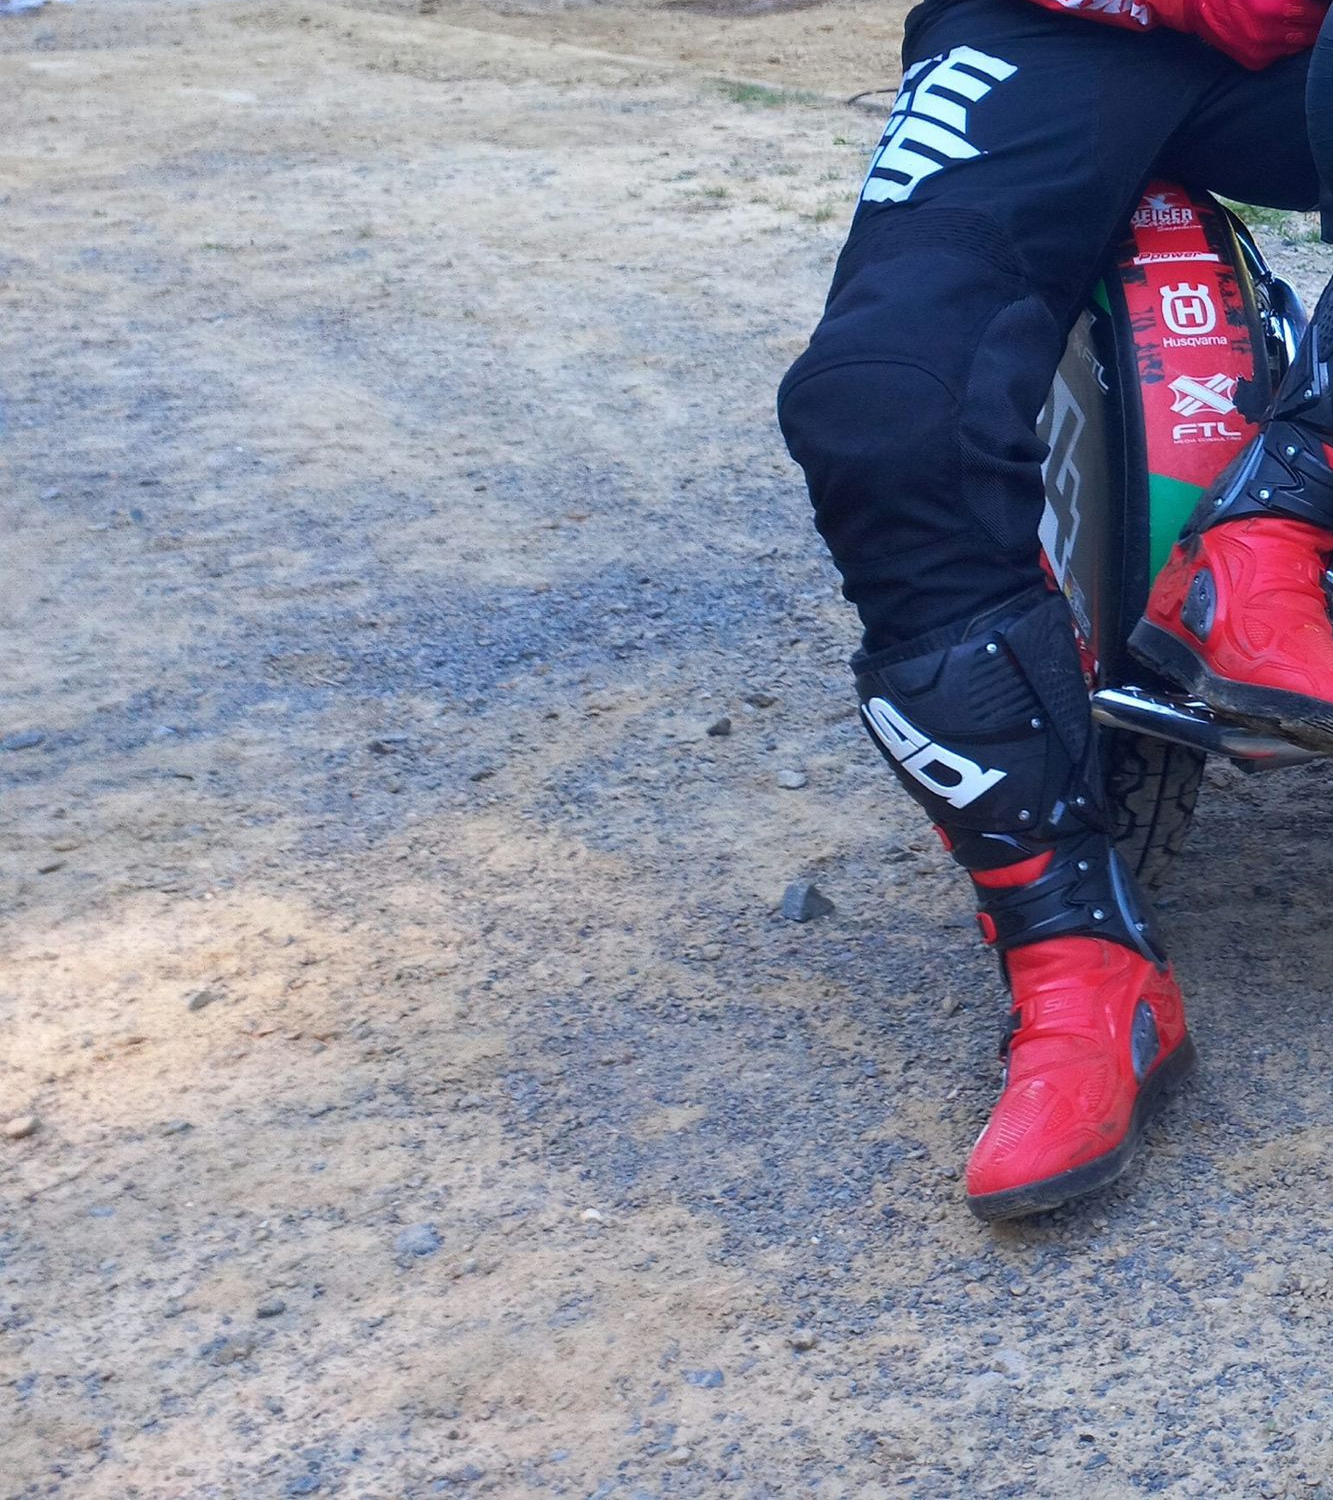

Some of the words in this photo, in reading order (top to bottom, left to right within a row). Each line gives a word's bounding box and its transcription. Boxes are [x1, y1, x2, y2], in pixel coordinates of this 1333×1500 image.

[1138, 250, 1202, 261] Ppower
[1162, 336, 1228, 348] Husqvarna
[1172, 421, 1242, 440] FTL
